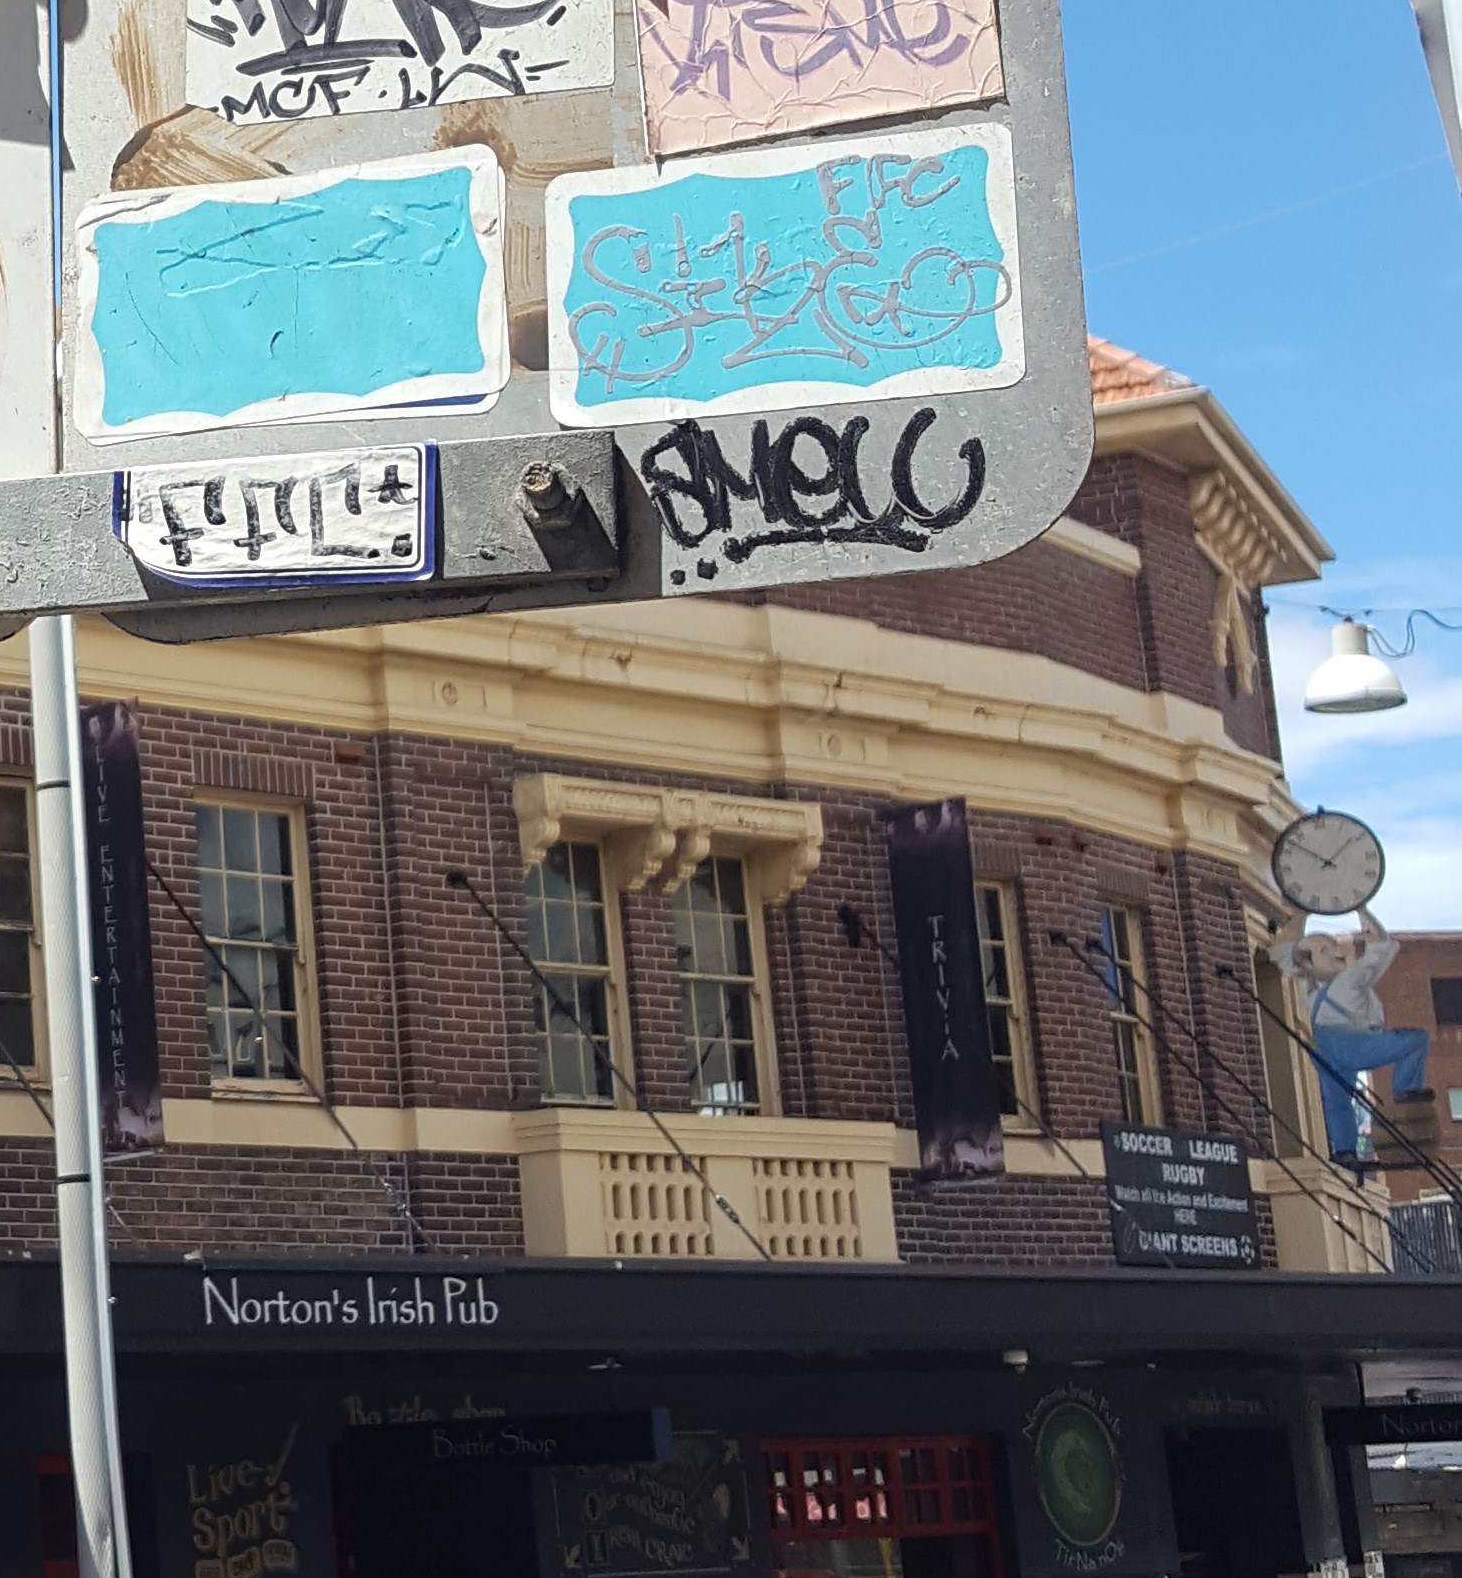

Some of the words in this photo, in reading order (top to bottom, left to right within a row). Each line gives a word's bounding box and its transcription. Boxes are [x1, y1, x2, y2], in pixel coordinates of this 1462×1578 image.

[94, 745, 110, 822] LIVE
[100, 844, 126, 1108] ENTERTAINMENT
[928, 915, 959, 1061] TRIVIA
[1121, 1132, 1172, 1156] SOCCER
[1189, 1140, 1238, 1164] LEAGUE
[1162, 1163, 1205, 1186] RUGBY
[1192, 1193, 1208, 1208] and
[1180, 1234, 1238, 1258] SCREENS
[202, 1276, 359, 1325] Norton's
[366, 1276, 435, 1325] Irish
[443, 1276, 499, 1325] Pub
